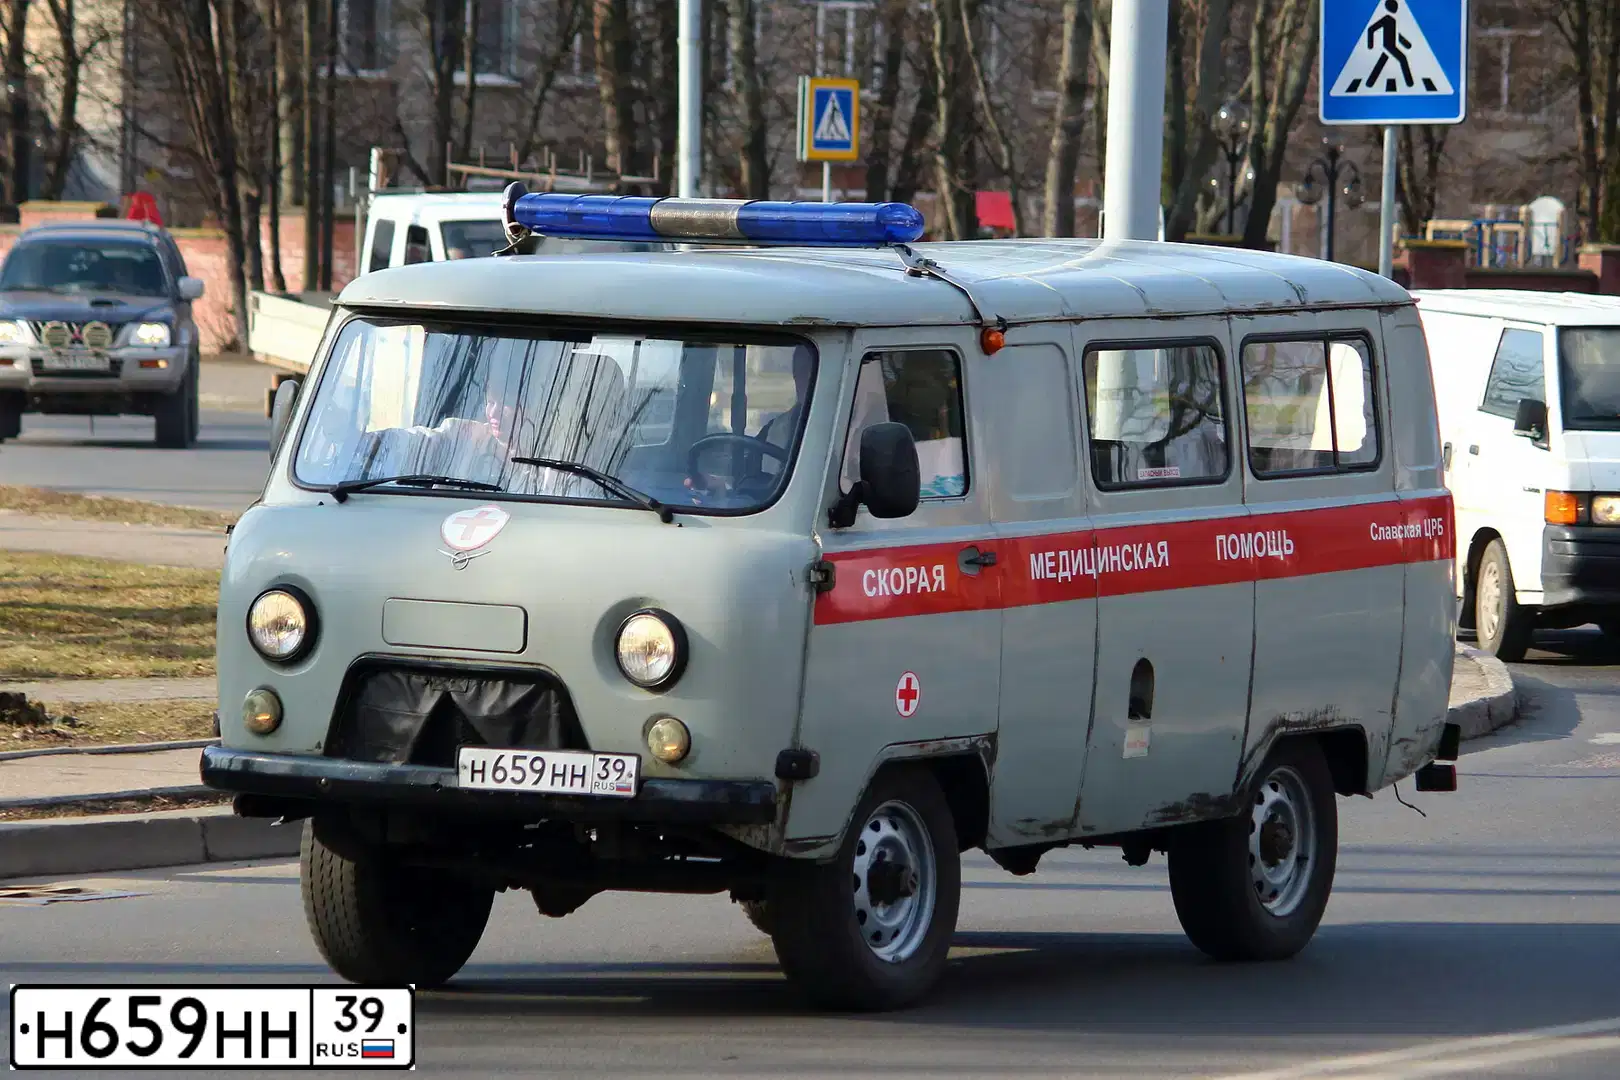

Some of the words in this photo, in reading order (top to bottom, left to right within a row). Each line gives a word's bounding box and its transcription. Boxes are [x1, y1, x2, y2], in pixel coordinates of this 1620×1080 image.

[1370, 522, 1422, 541] Славская
[1423, 517, 1444, 540] ЦРБ
[862, 564, 946, 597] СКОРАЯ
[1029, 540, 1170, 583] МЕДИЦИНСКАЯ
[1215, 529, 1295, 561] ПОМОЩЬ
[470, 754, 587, 788] Н659НН
[596, 757, 626, 781] 39
[593, 781, 615, 792] RUS
